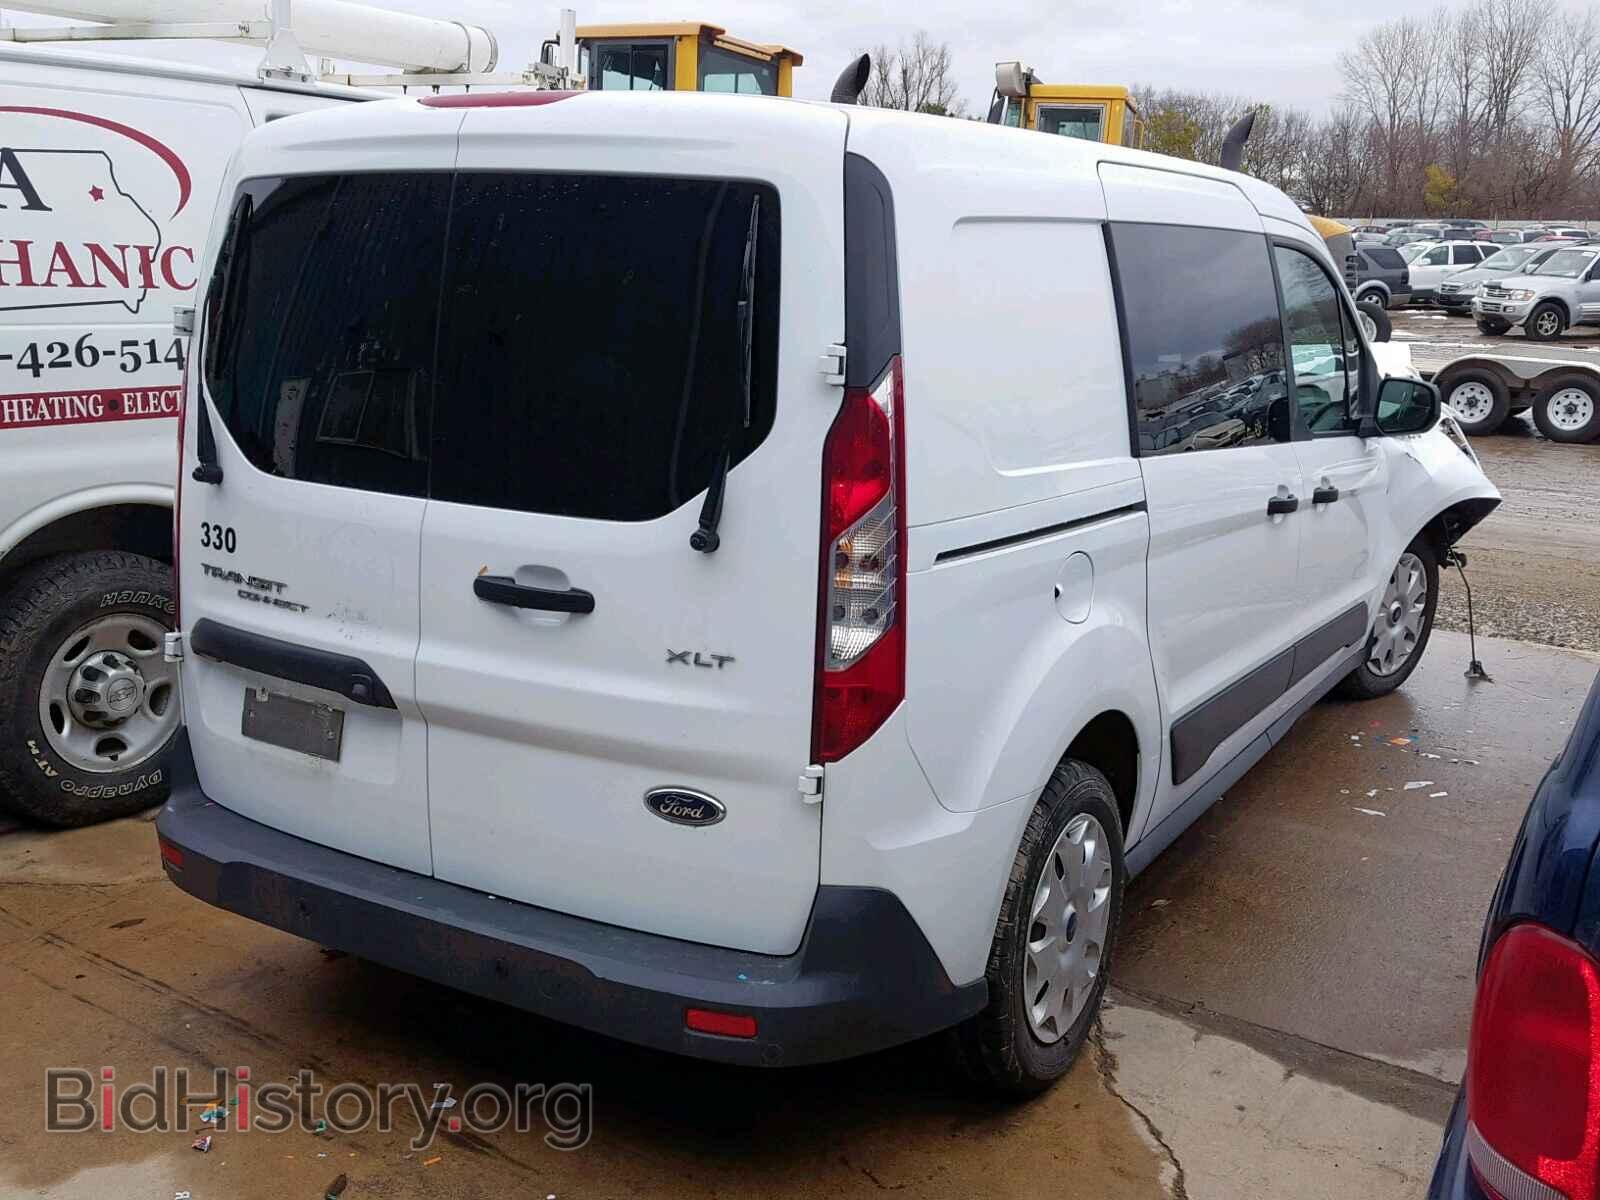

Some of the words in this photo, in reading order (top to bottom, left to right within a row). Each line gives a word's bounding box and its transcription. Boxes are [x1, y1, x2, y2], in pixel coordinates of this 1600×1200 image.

[0, 147, 53, 211] A
[0, 239, 197, 290] HANIC
[3, 393, 104, 423] HEATING
[200, 521, 237, 553] 330
[200, 562, 288, 595] TRANSIT
[665, 648, 736, 670] XLT
[660, 795, 705, 819] Ford
